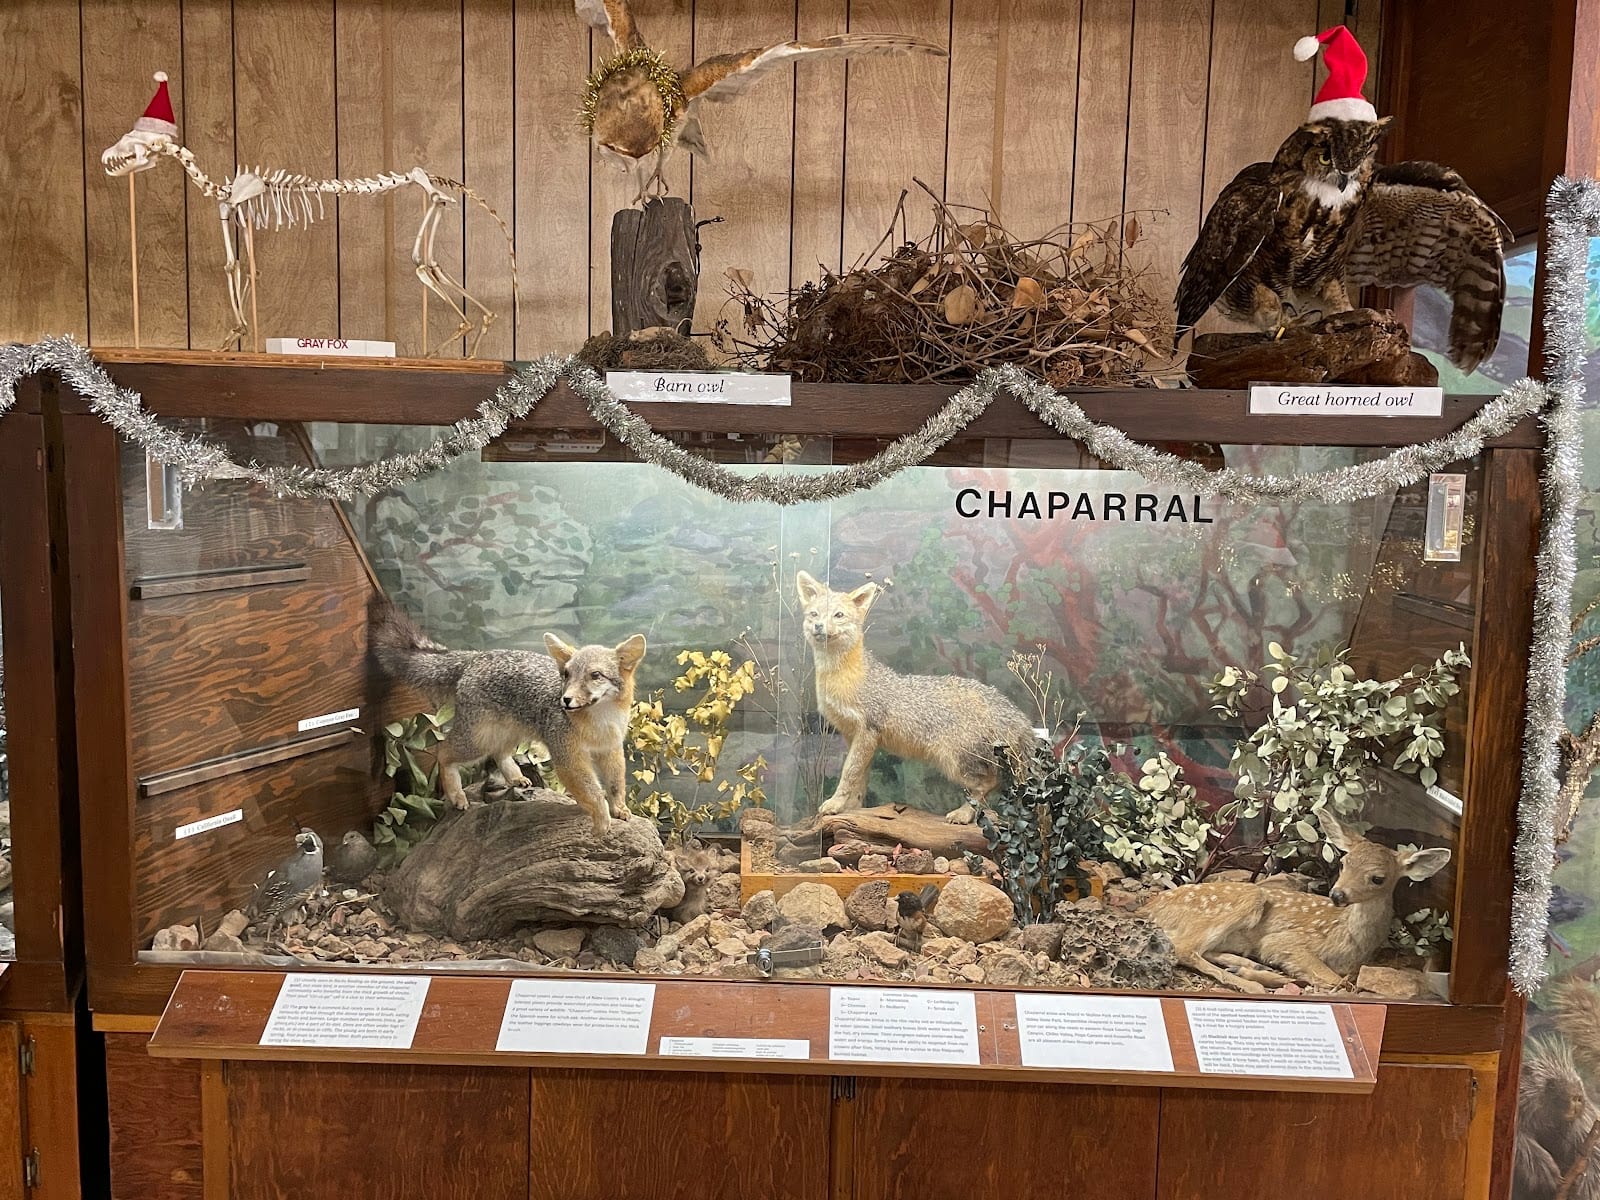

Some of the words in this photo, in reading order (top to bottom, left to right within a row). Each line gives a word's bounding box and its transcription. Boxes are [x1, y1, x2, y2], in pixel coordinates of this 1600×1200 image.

[297, 338, 324, 349] GRAY
[328, 339, 349, 349] FOX
[654, 376, 692, 392] Barn
[697, 379, 725, 393] owl
[1278, 392, 1320, 406] Great
[1325, 392, 1382, 406] horned
[1385, 392, 1414, 407] owl
[955, 488, 1213, 523] CHAPARRAL
[197, 819, 221, 831] California
[222, 814, 236, 823] Quail
